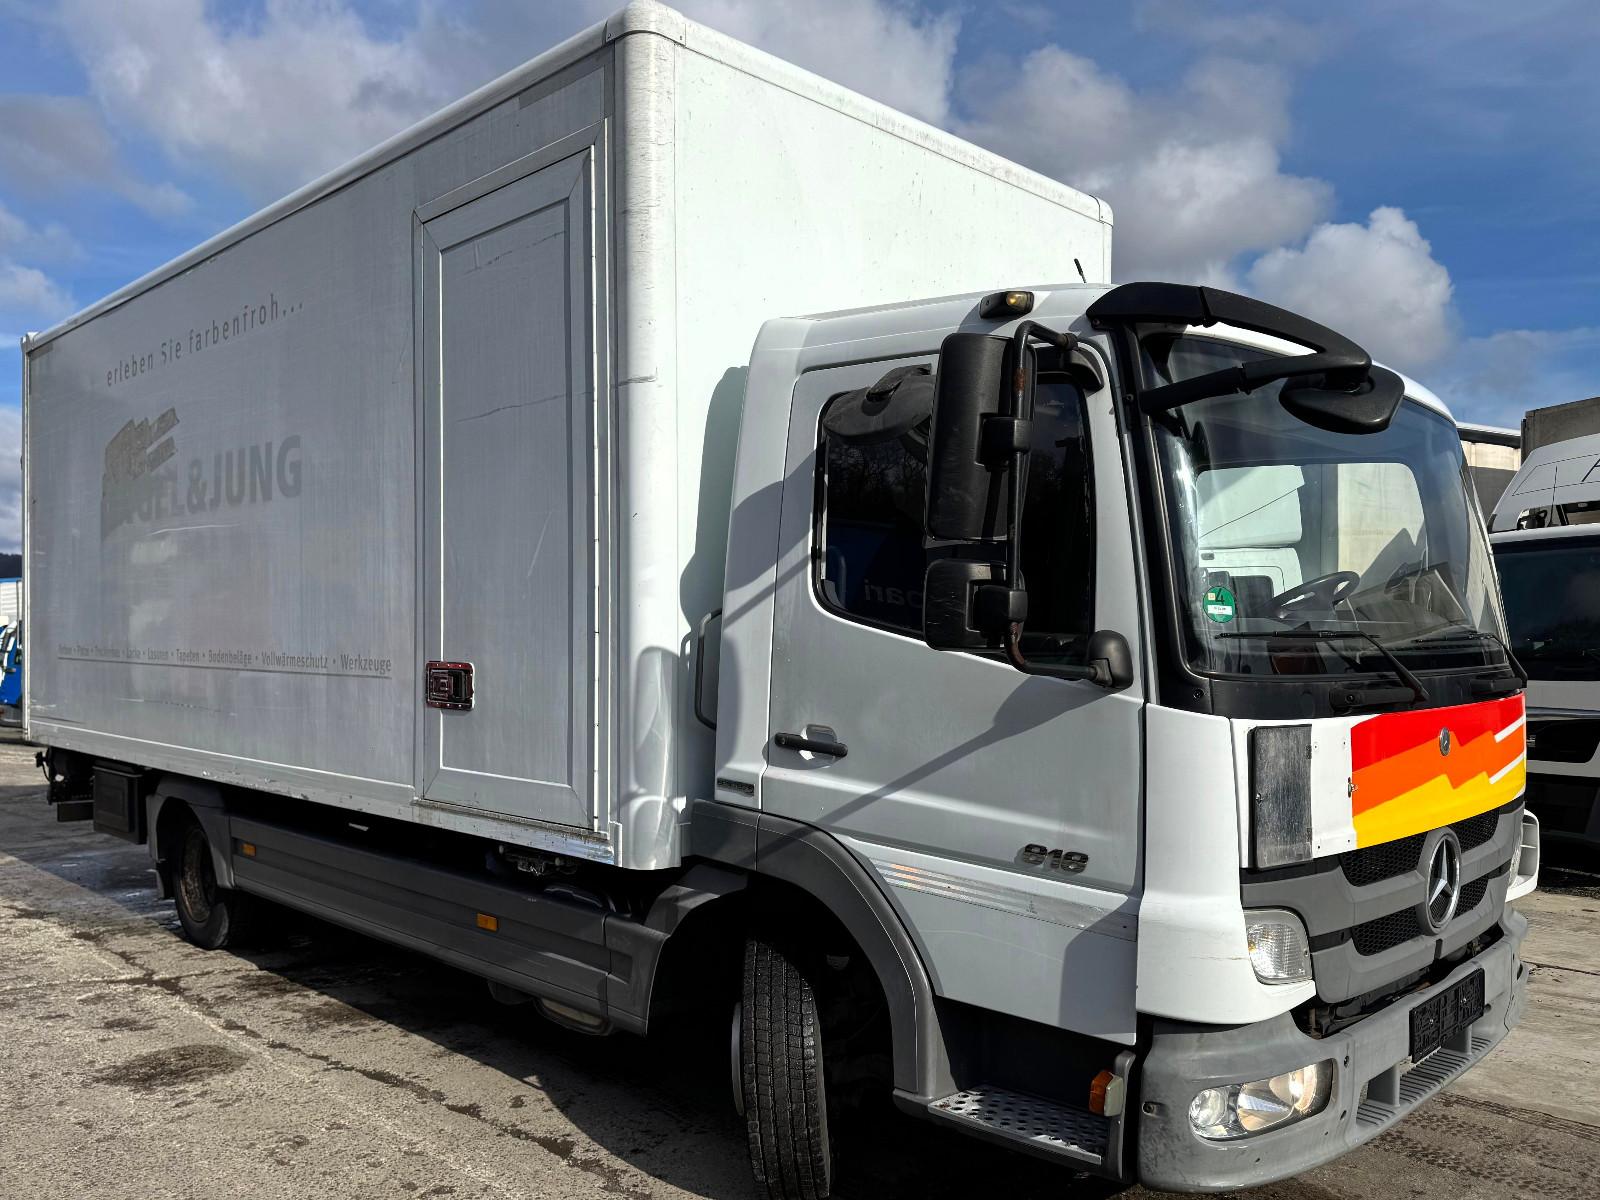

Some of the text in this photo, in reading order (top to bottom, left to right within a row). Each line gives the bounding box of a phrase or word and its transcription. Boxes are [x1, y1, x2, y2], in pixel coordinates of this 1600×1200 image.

[107, 354, 153, 387] erleben
[161, 339, 182, 365] Sie
[1215, 587, 1225, 606] 4
[208, 649, 252, 667] Bodenbeläge
[261, 651, 328, 669] Vollwärmeschutz
[340, 653, 392, 675] Werkzeuge
